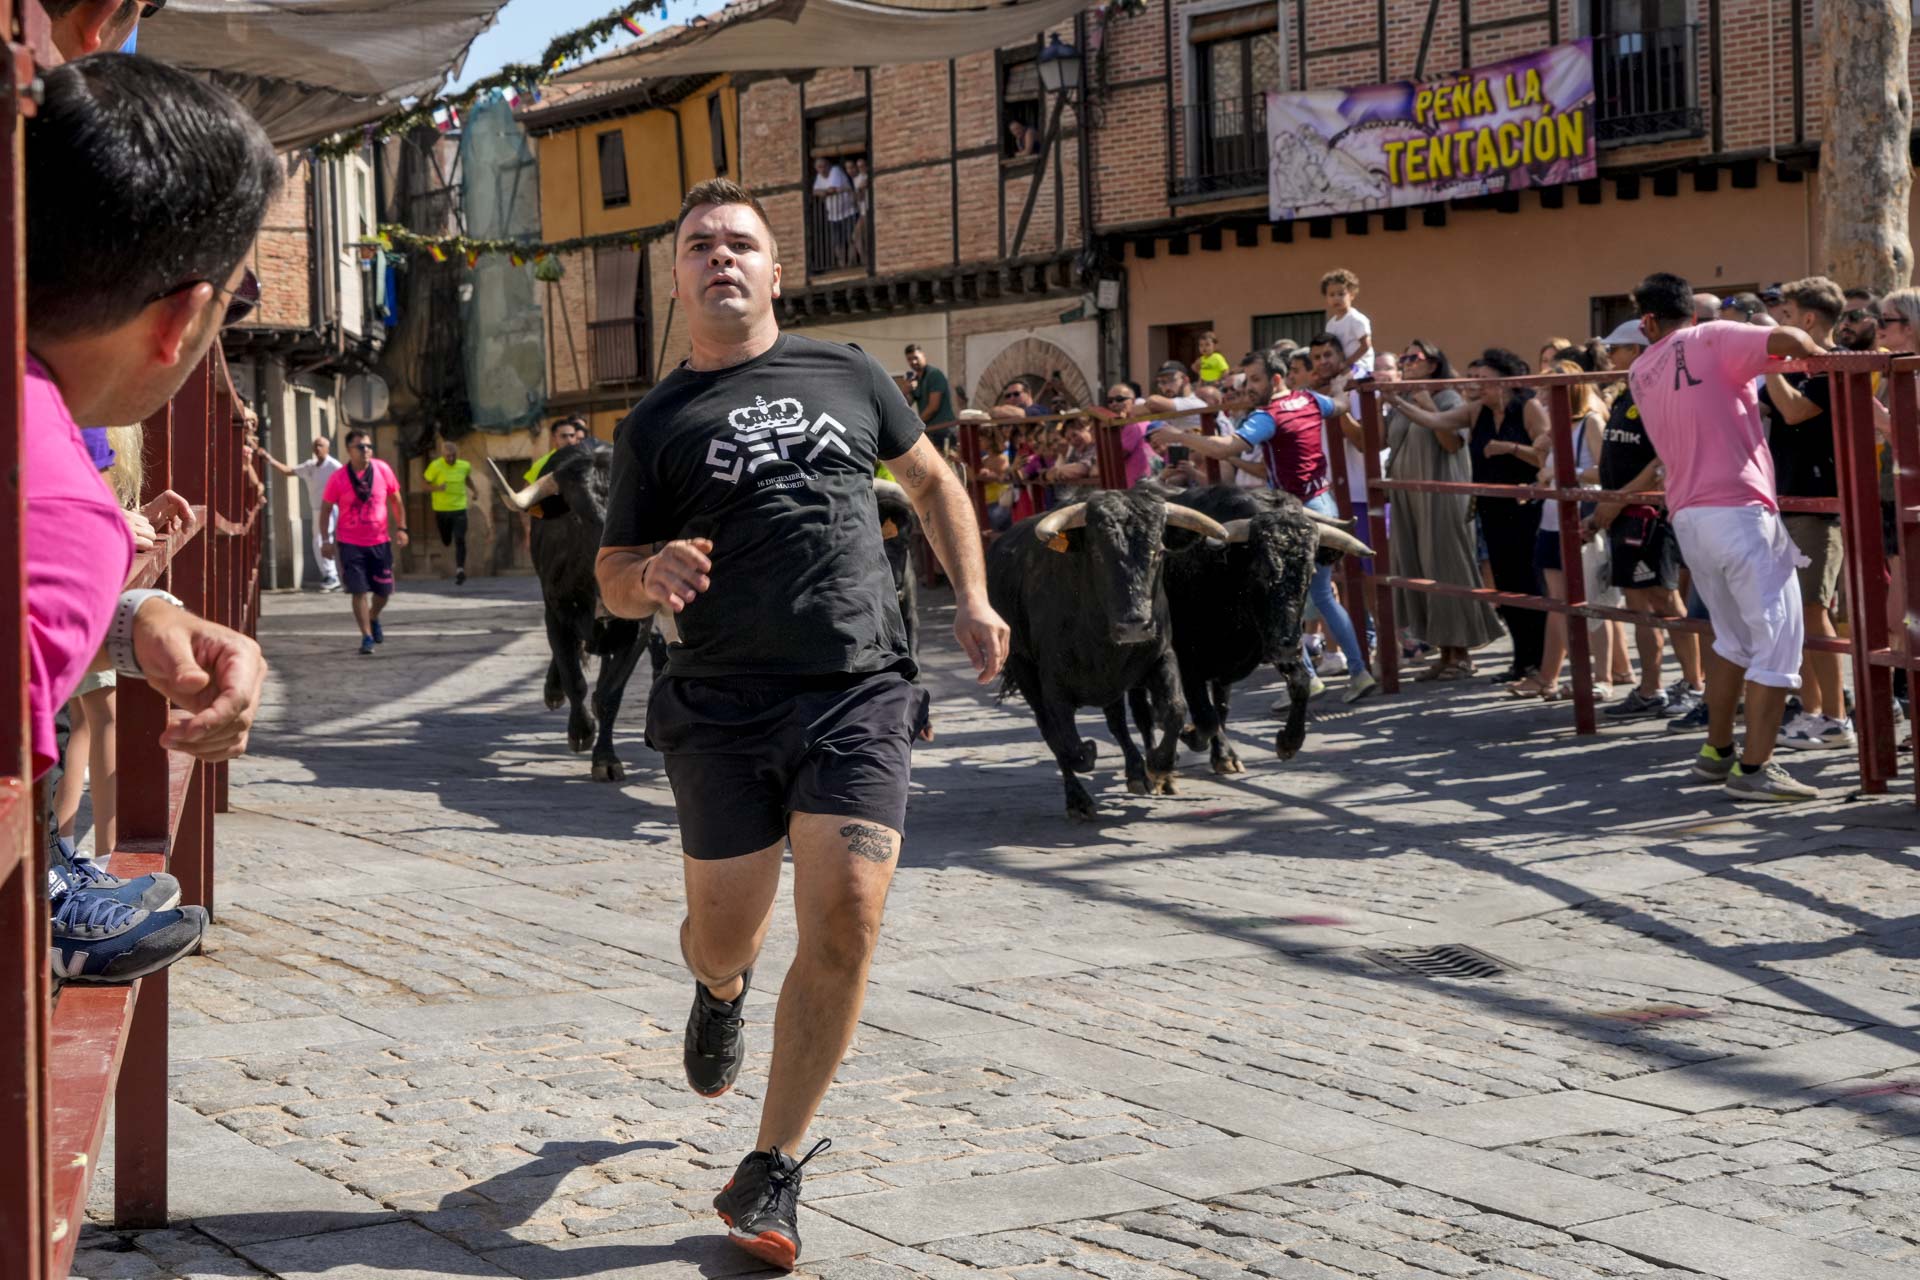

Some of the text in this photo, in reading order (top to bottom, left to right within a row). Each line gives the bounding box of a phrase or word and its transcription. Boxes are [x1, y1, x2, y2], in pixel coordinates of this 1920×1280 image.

[1415, 68, 1541, 124] PEÑA LA
[1384, 103, 1585, 185] TENTACIÓN
[775, 480, 804, 489] MADRID
